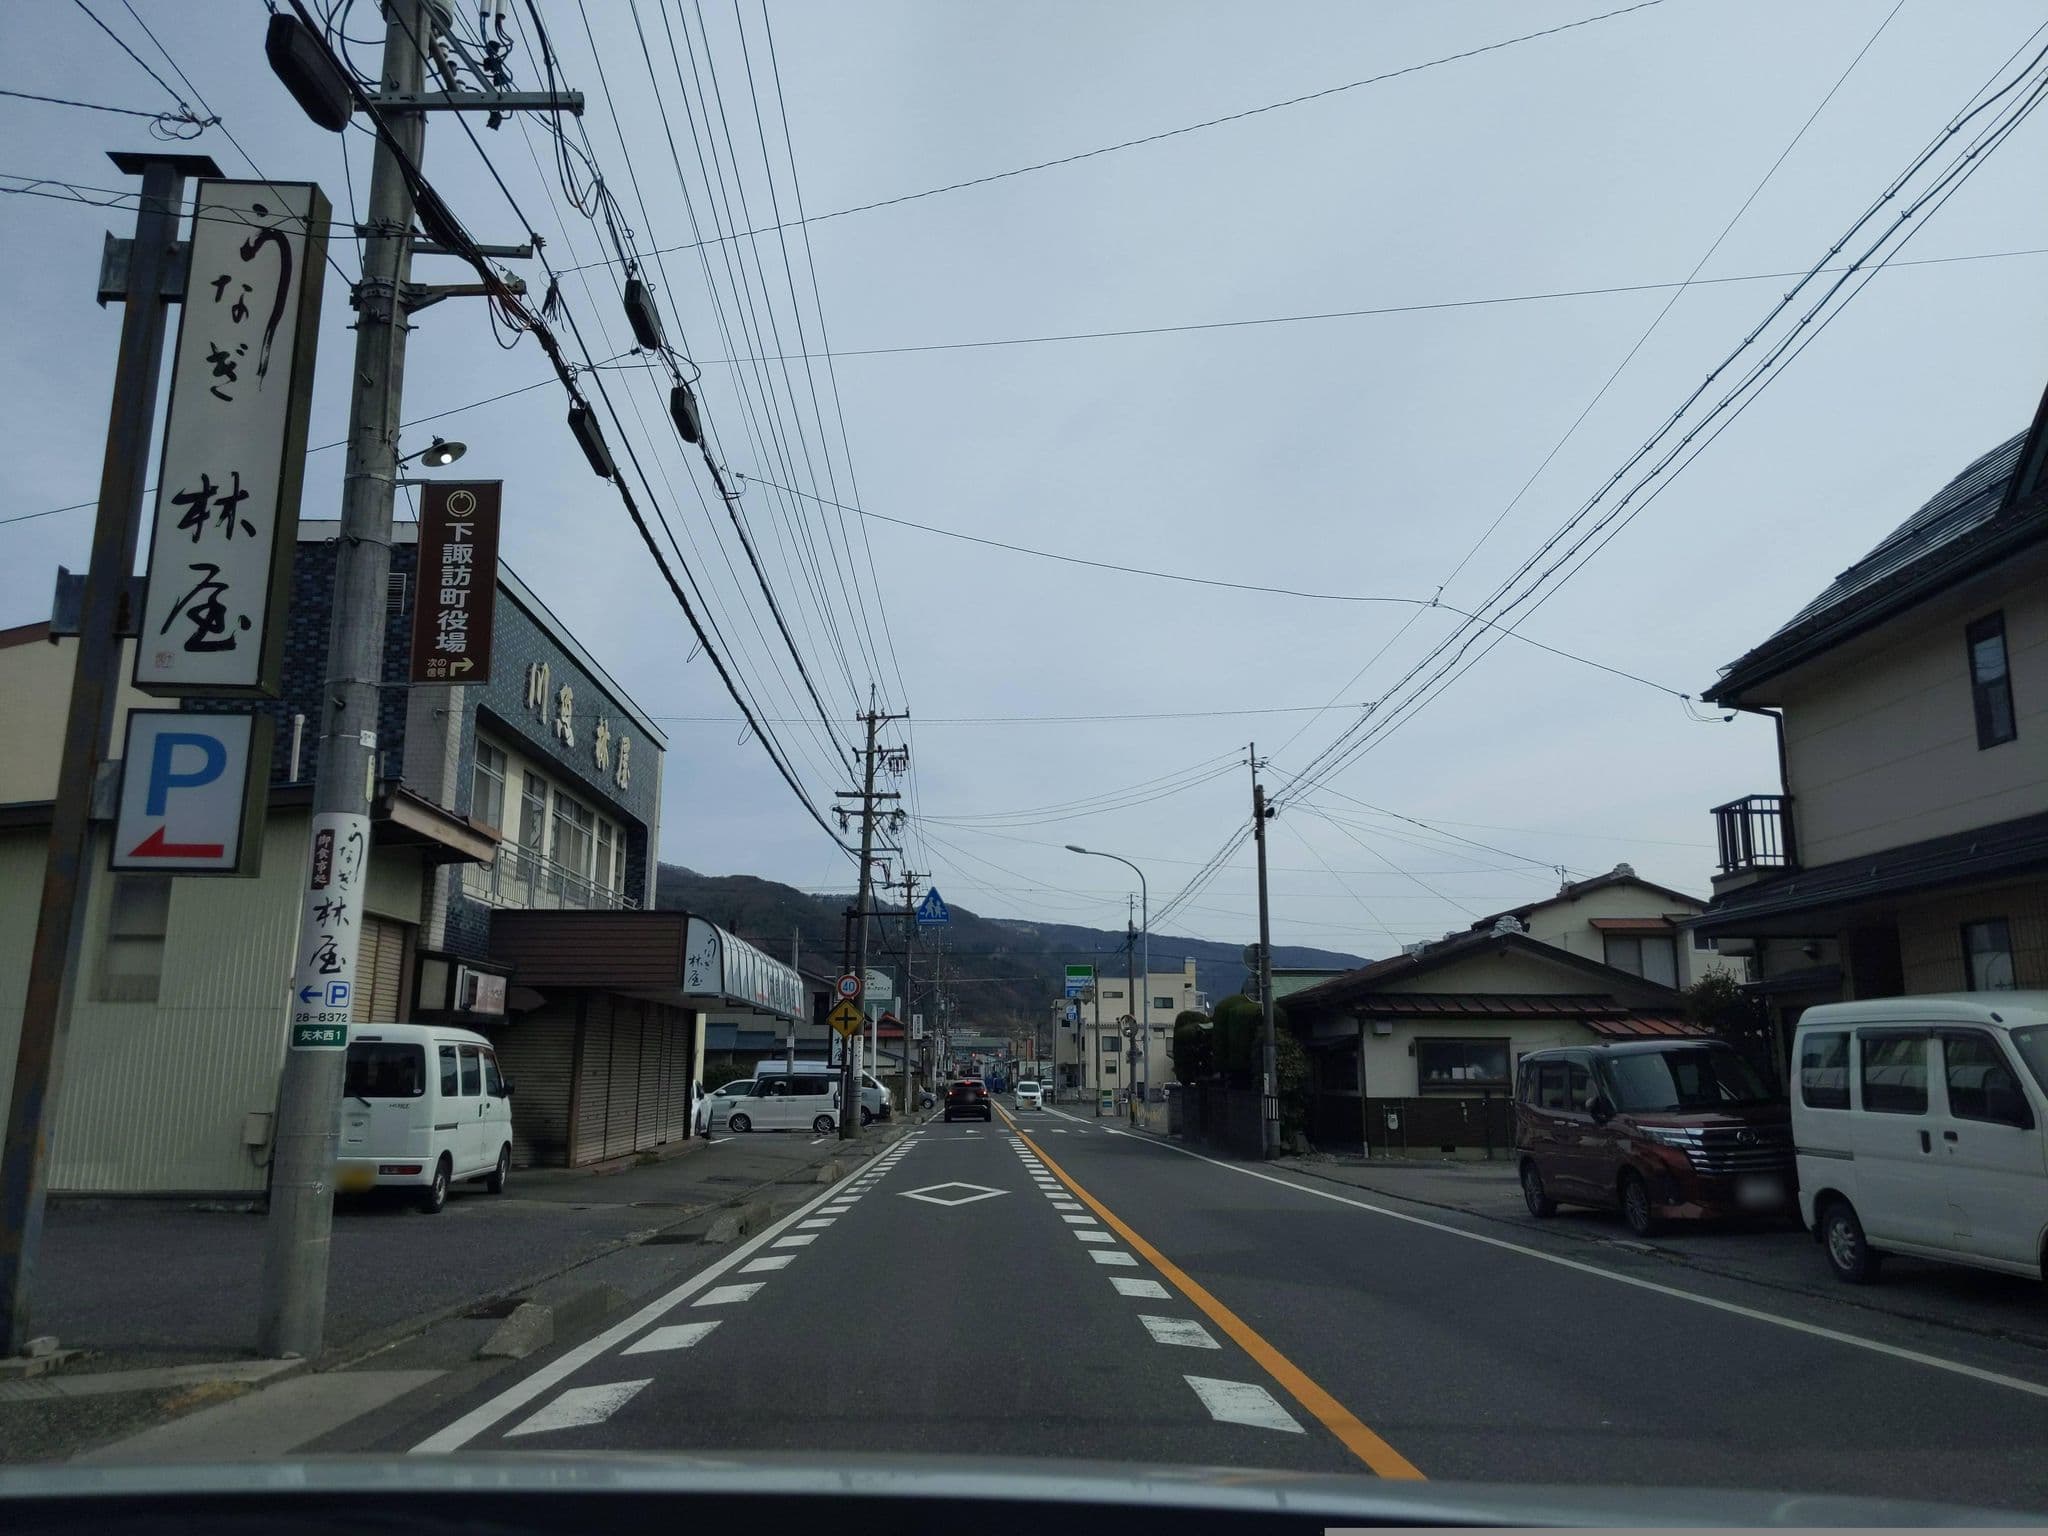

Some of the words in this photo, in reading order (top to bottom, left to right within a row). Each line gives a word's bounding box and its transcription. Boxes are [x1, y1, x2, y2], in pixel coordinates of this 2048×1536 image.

[206, 204, 292, 402] うなぎ
[161, 472, 257, 653] 林屋
[434, 522, 475, 653] 下諏訪町役場
[426, 668, 446, 678] 信号
[427, 658, 447, 667] 次の
[145, 732, 228, 817] P
[312, 833, 334, 885] 御食事処
[338, 822, 364, 891] うなぎ
[309, 896, 350, 975] 林屋
[330, 985, 348, 1005] P
[842, 980, 856, 993] 40
[295, 1012, 348, 1023] 28-8372
[300, 1029, 342, 1041] 矢木西1
